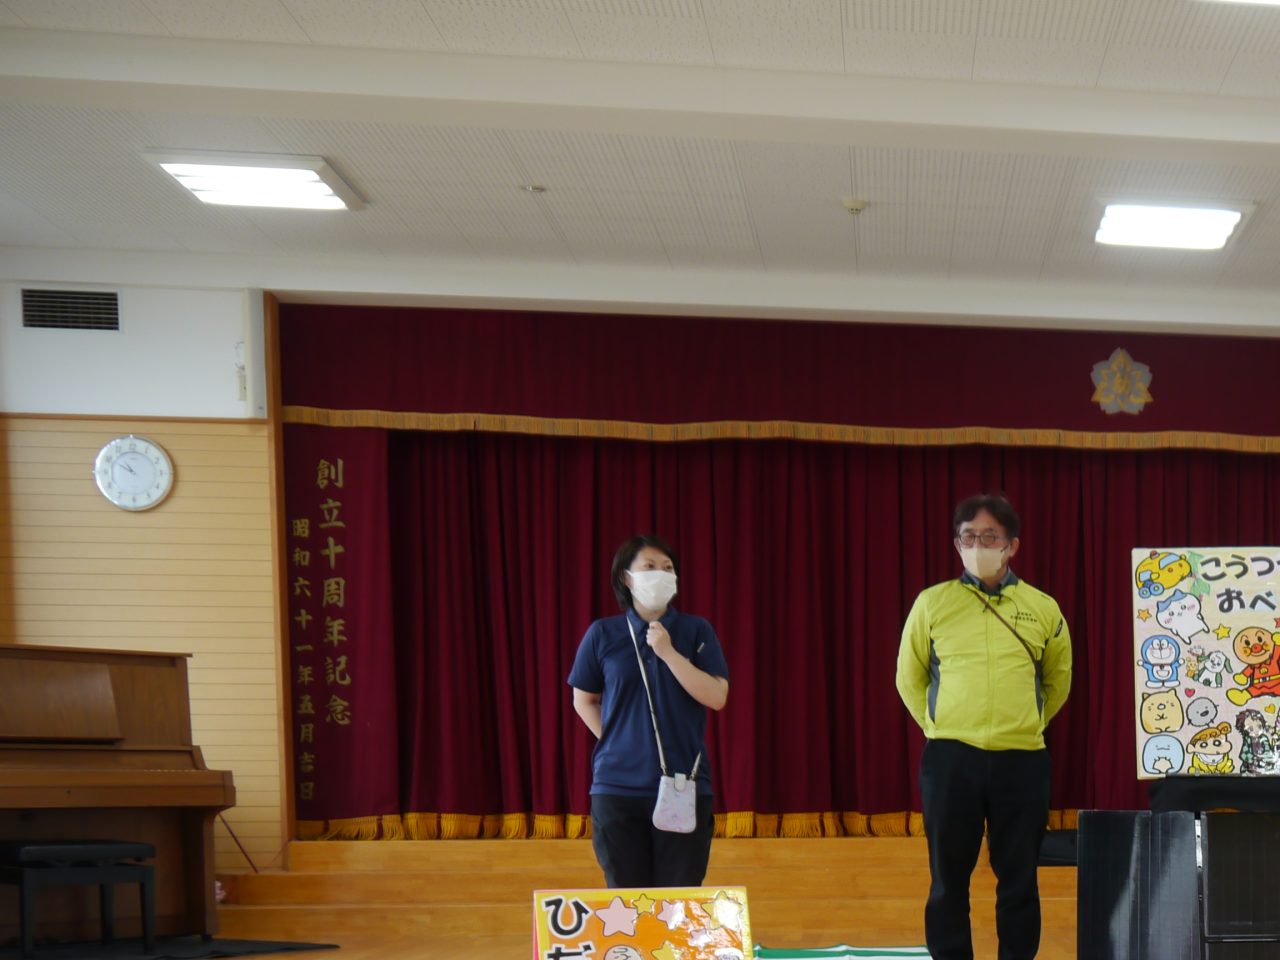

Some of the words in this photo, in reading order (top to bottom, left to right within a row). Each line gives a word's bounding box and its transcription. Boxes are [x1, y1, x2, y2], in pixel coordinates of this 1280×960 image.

[292, 518, 315, 801] 昭和六十一年五月吉日
[316, 458, 352, 726] 創立十周年記念
